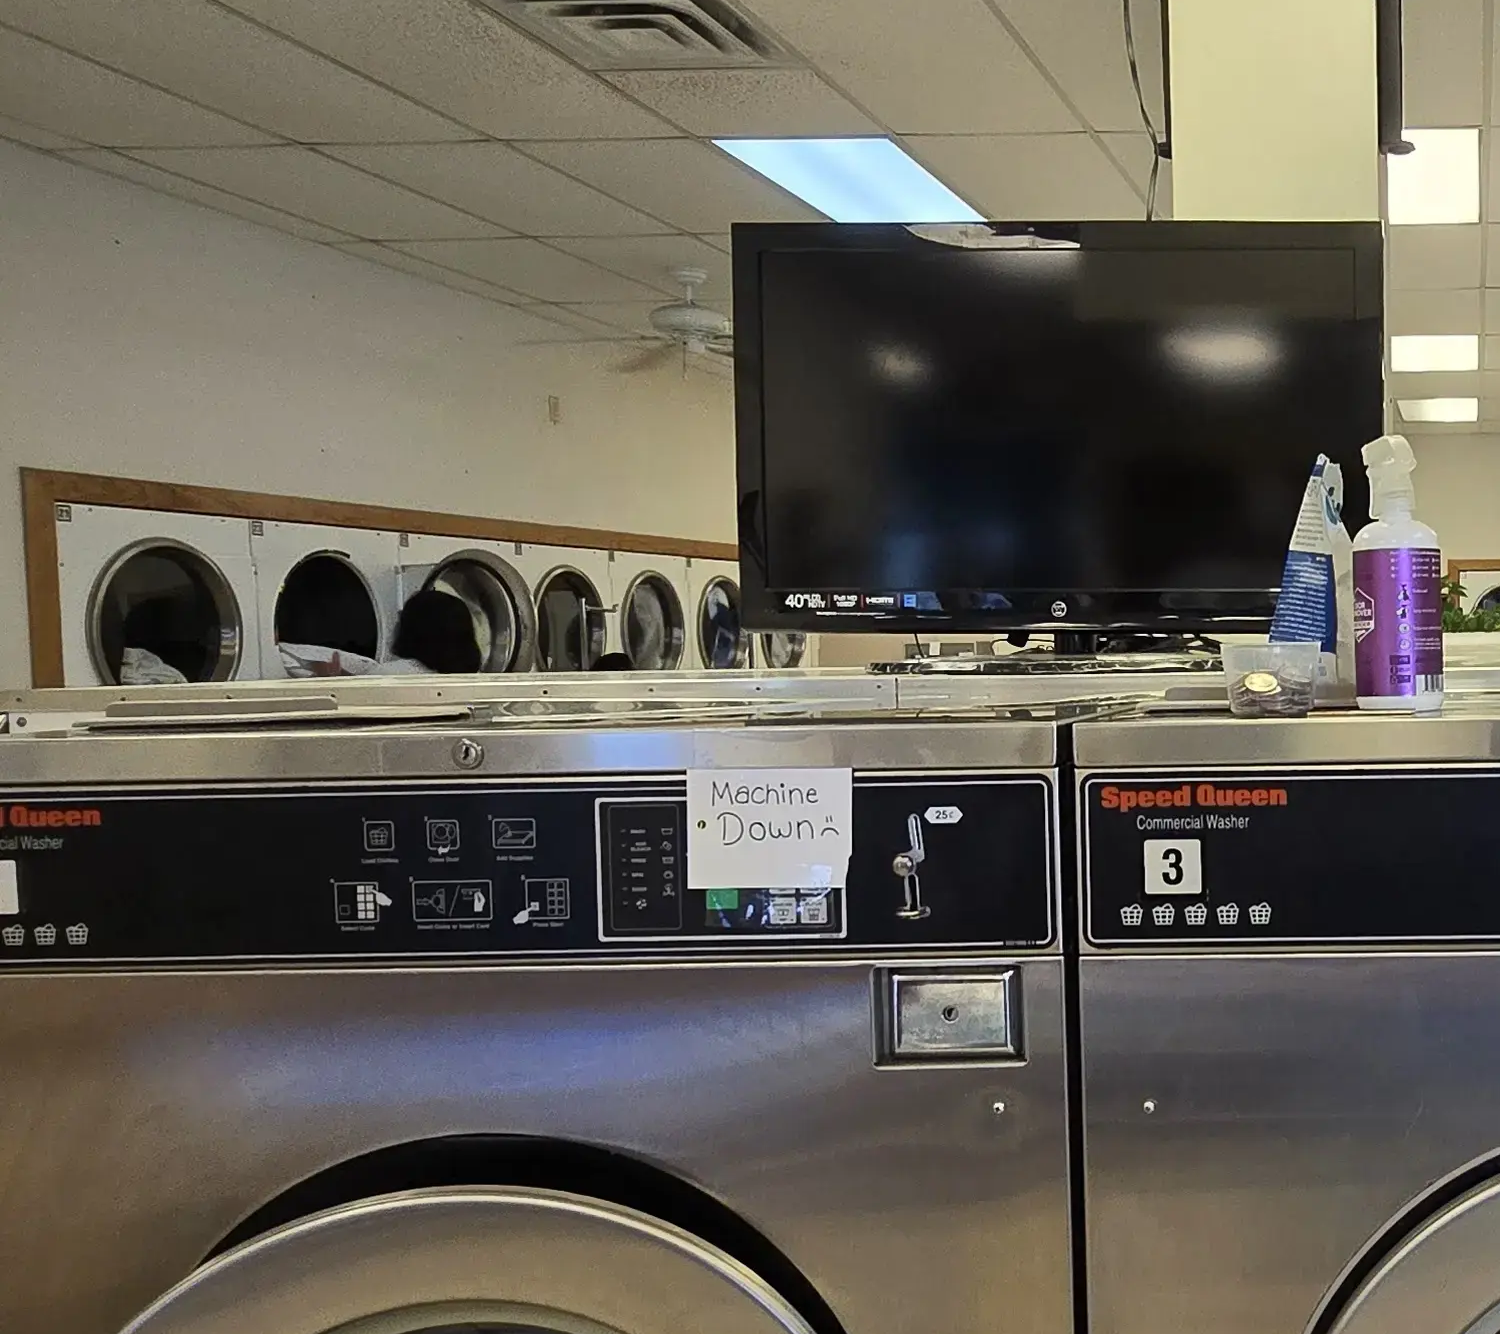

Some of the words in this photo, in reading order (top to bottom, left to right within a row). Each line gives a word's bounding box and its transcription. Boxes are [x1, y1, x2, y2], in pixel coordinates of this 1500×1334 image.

[711, 781, 819, 807] Machine
[1100, 785, 1191, 812] Speed
[1196, 784, 1287, 806] Queen
[9, 805, 101, 827] Queen
[716, 811, 816, 846] Down
[1136, 814, 1204, 830] Commercial
[1206, 814, 1250, 829] Washer
[20, 835, 64, 850] Washer
[1161, 848, 1183, 886] 3
